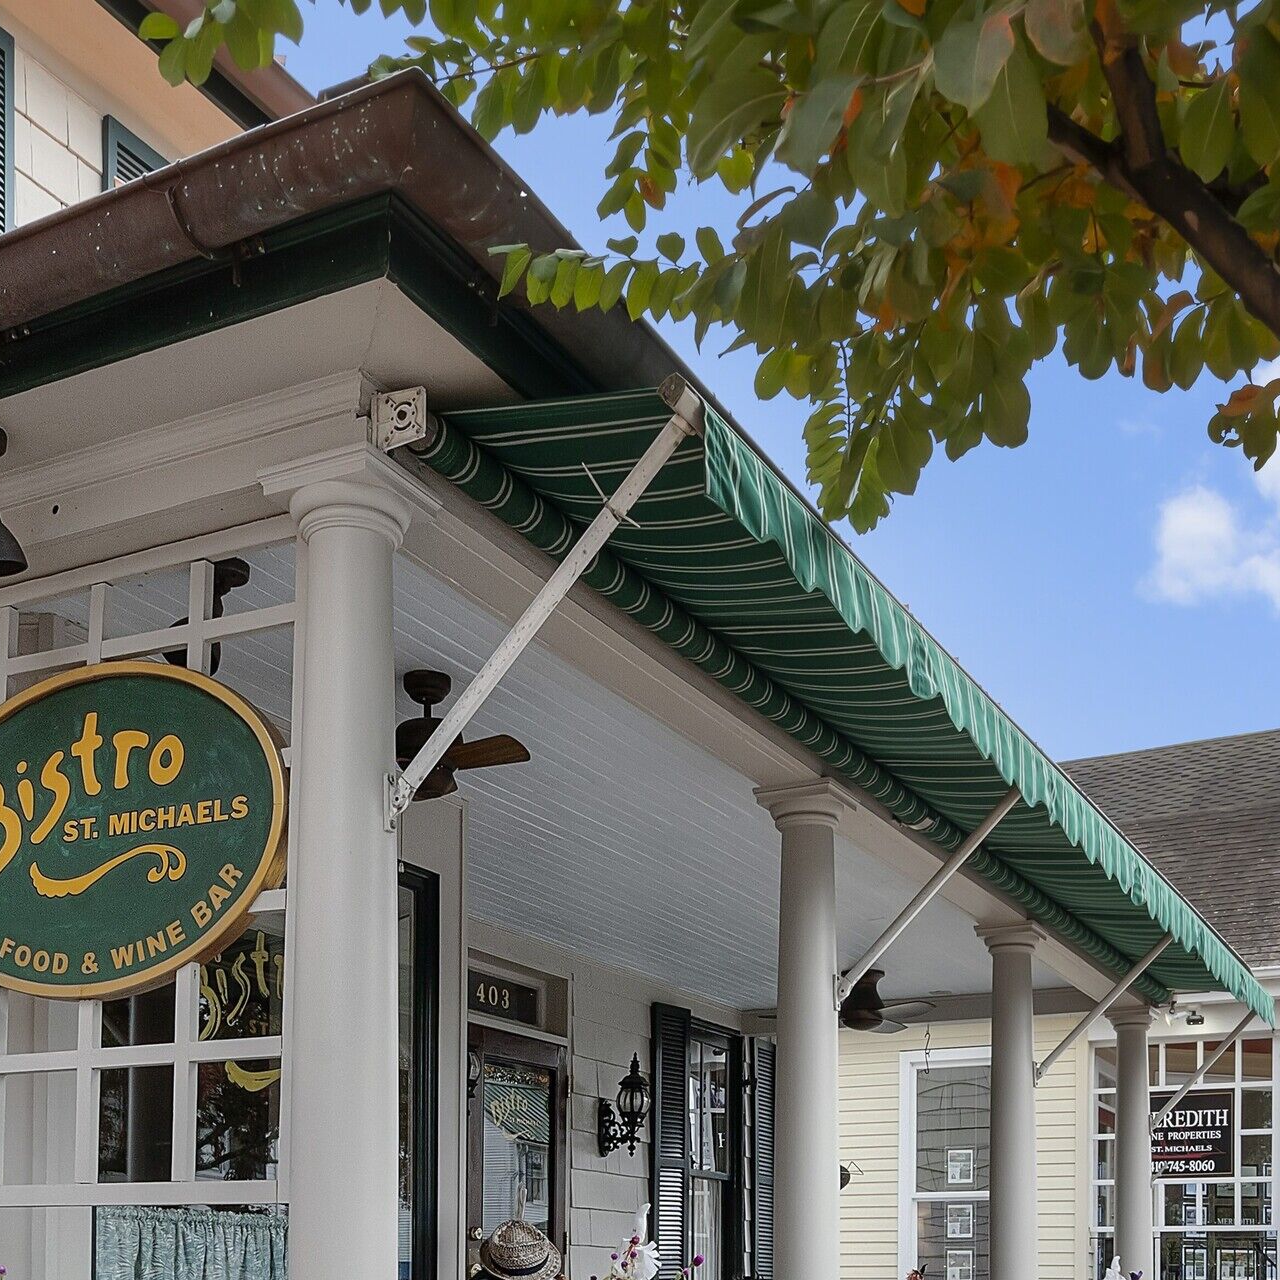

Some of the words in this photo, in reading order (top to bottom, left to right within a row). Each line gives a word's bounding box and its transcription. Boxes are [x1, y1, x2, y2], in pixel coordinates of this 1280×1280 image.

[63, 820, 99, 842] ST.
[109, 795, 249, 836] MICHAELS
[80, 951, 99, 974] &
[110, 920, 186, 969] WINE
[190, 862, 244, 928] BAR
[476, 982, 510, 1009] 403
[1165, 1144, 1213, 1153] MICHAELS
[1167, 1130, 1222, 1141] PROPERTIES
